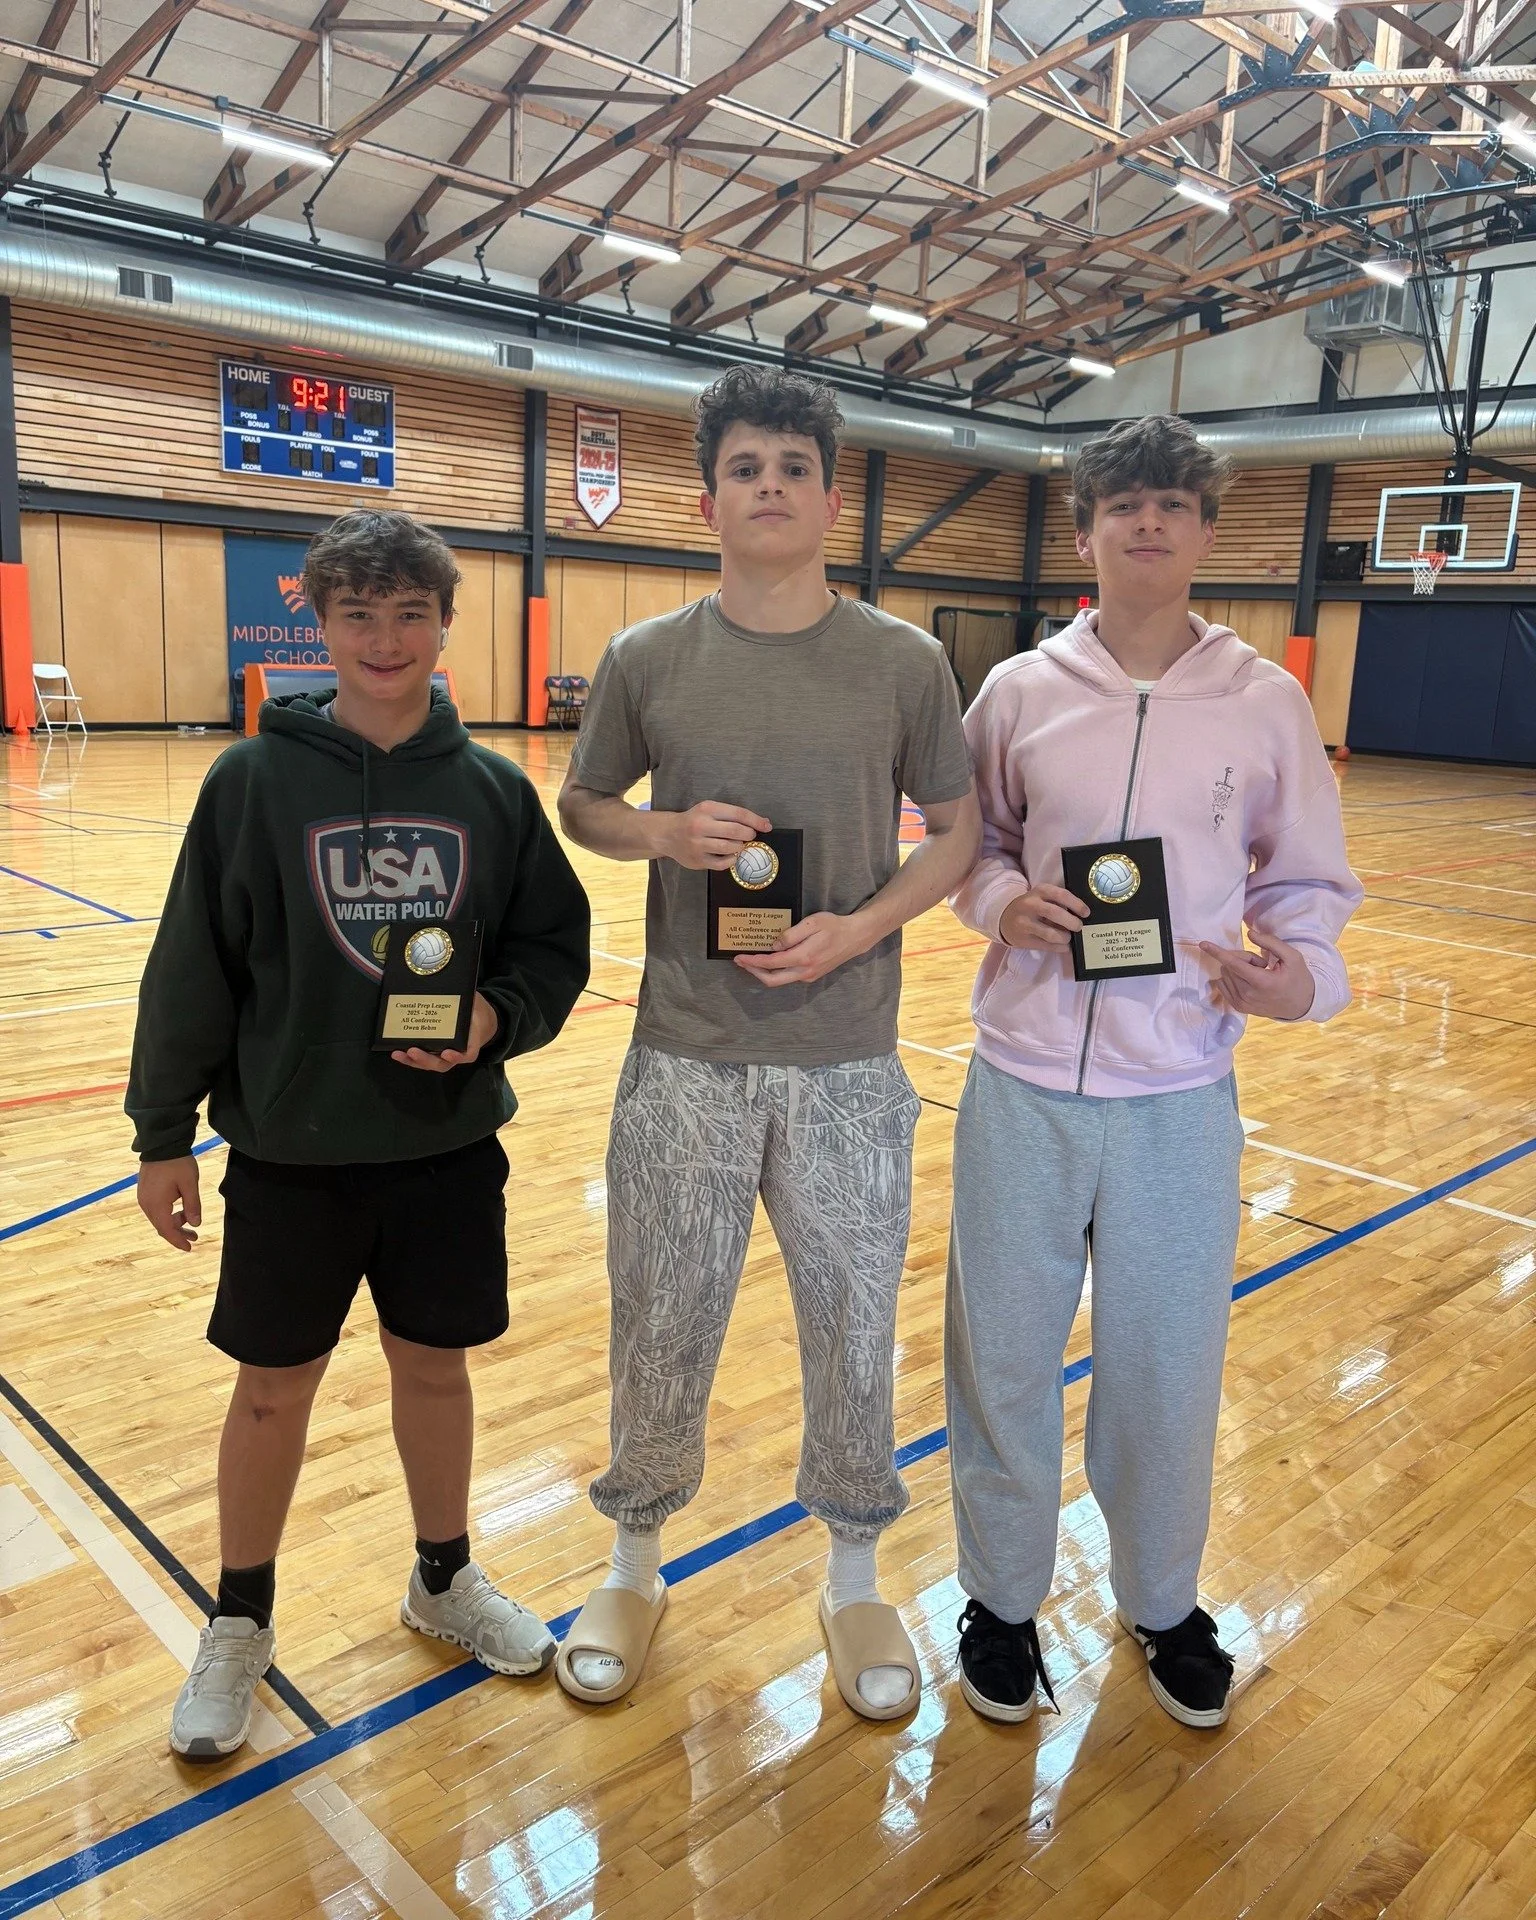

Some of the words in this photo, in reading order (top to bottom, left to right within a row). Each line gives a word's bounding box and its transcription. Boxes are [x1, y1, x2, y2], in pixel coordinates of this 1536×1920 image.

[228, 366, 270, 384] HOME
[293, 378, 345, 412] 9:21
[349, 386, 390, 403] GUEST
[240, 411, 257, 420] POSS
[248, 420, 270, 429] BONUS
[302, 431, 322, 439] PERIOD
[364, 429, 379, 437] POSS
[241, 435, 261, 443] FOULS
[352, 435, 373, 443] BONUS
[290, 441, 312, 450] PLAYER
[321, 445, 336, 453] FOUL
[241, 463, 262, 471] SCORE
[329, 847, 448, 898] USA
[336, 902, 397, 920] WATER
[401, 900, 446, 920] POLO
[1091, 931, 1113, 939] Coastal
[1130, 928, 1151, 936] League
[1120, 952, 1142, 960] Epstein
